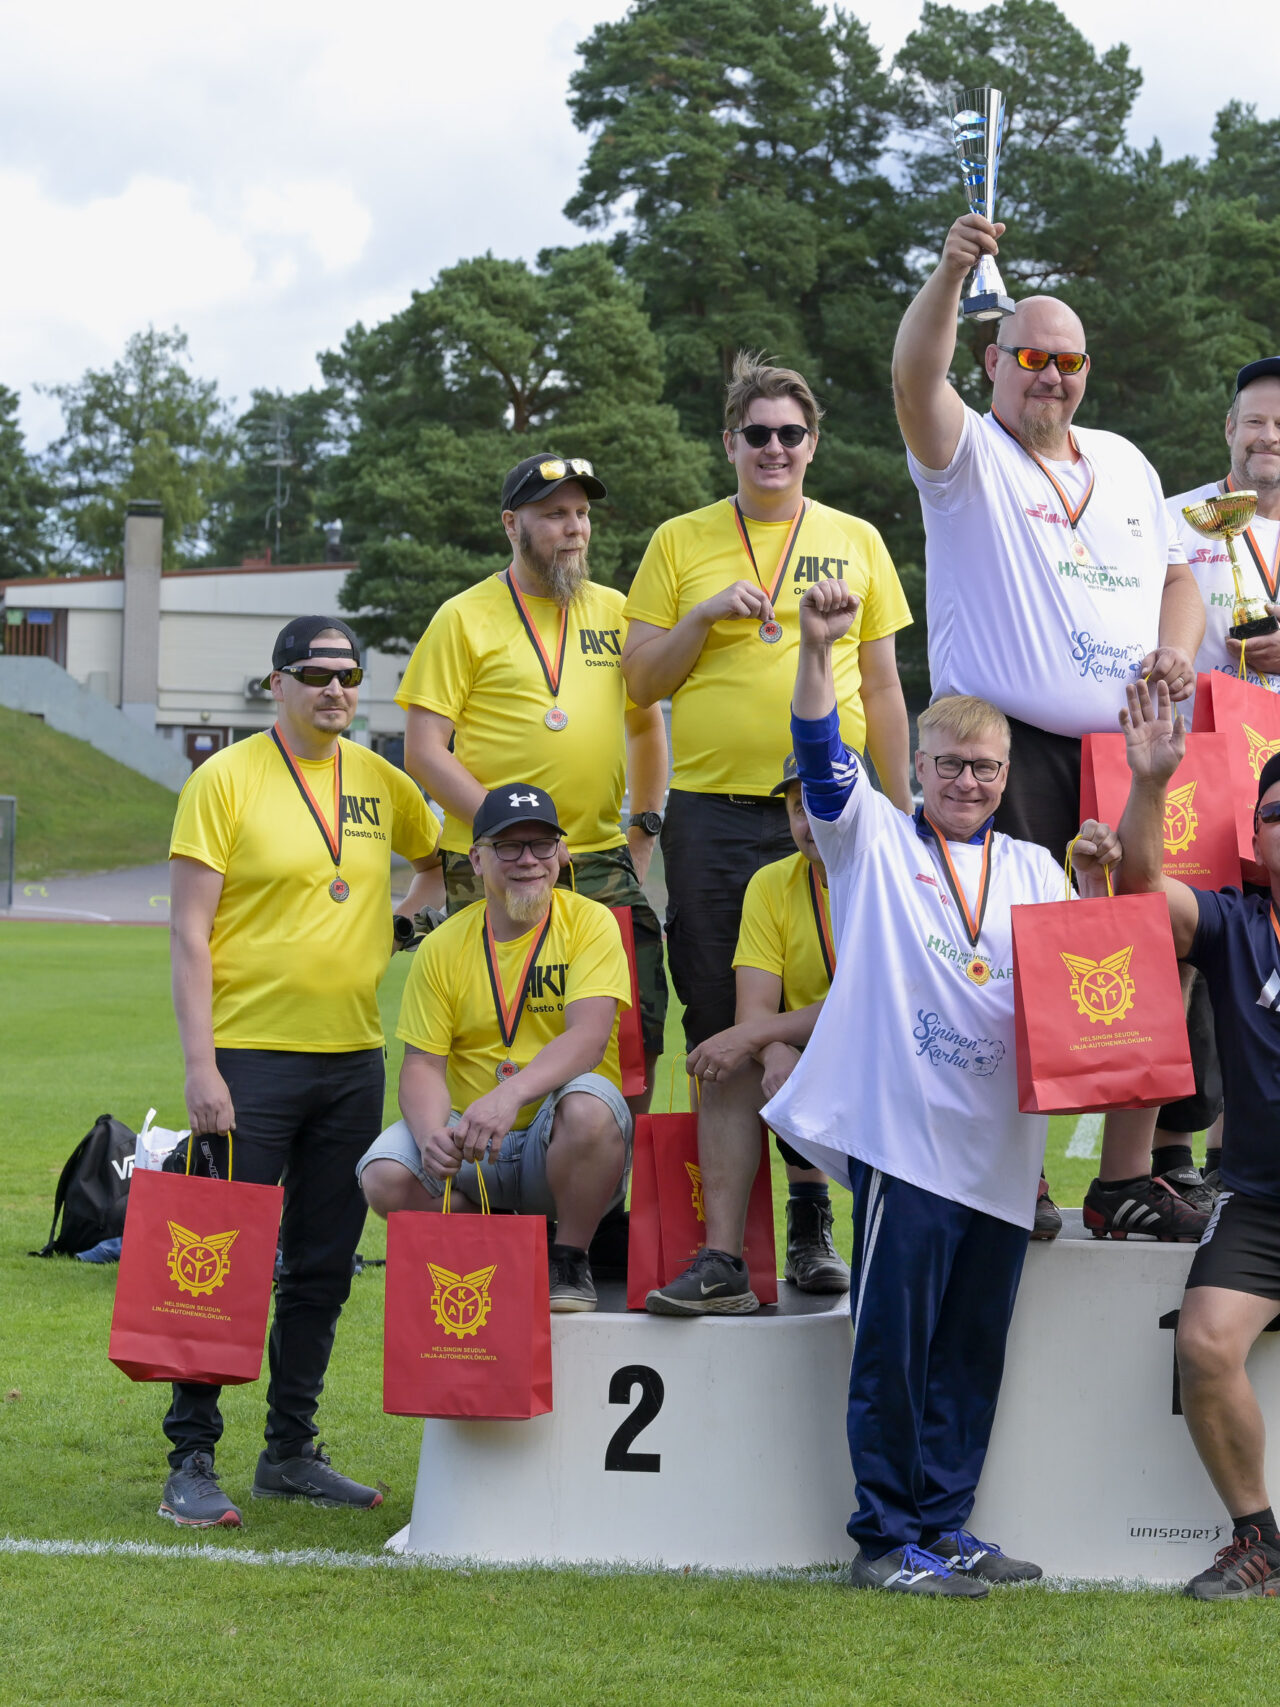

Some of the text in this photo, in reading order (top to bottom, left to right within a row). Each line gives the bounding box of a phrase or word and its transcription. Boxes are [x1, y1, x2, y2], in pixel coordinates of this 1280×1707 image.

[1127, 518, 1140, 527] AKT
[794, 556, 849, 582] AKT
[579, 629, 622, 655] AKT
[1071, 631, 1128, 661] Sininen
[585, 660, 615, 668] Osasto
[1080, 654, 1126, 683] Karhu
[341, 795, 380, 826] AKT
[345, 829, 372, 838] Osasto
[526, 964, 569, 998] AKT
[913, 1009, 978, 1051] Sininen
[1080, 1030, 1140, 1043] HELSINGIN SEUDUN
[916, 1035, 969, 1069] Karhu
[164, 1301, 221, 1313] HELSINGIN SEUDUN
[605, 1364, 665, 1473] 2
[1130, 1527, 1213, 1539] UNISPORT
